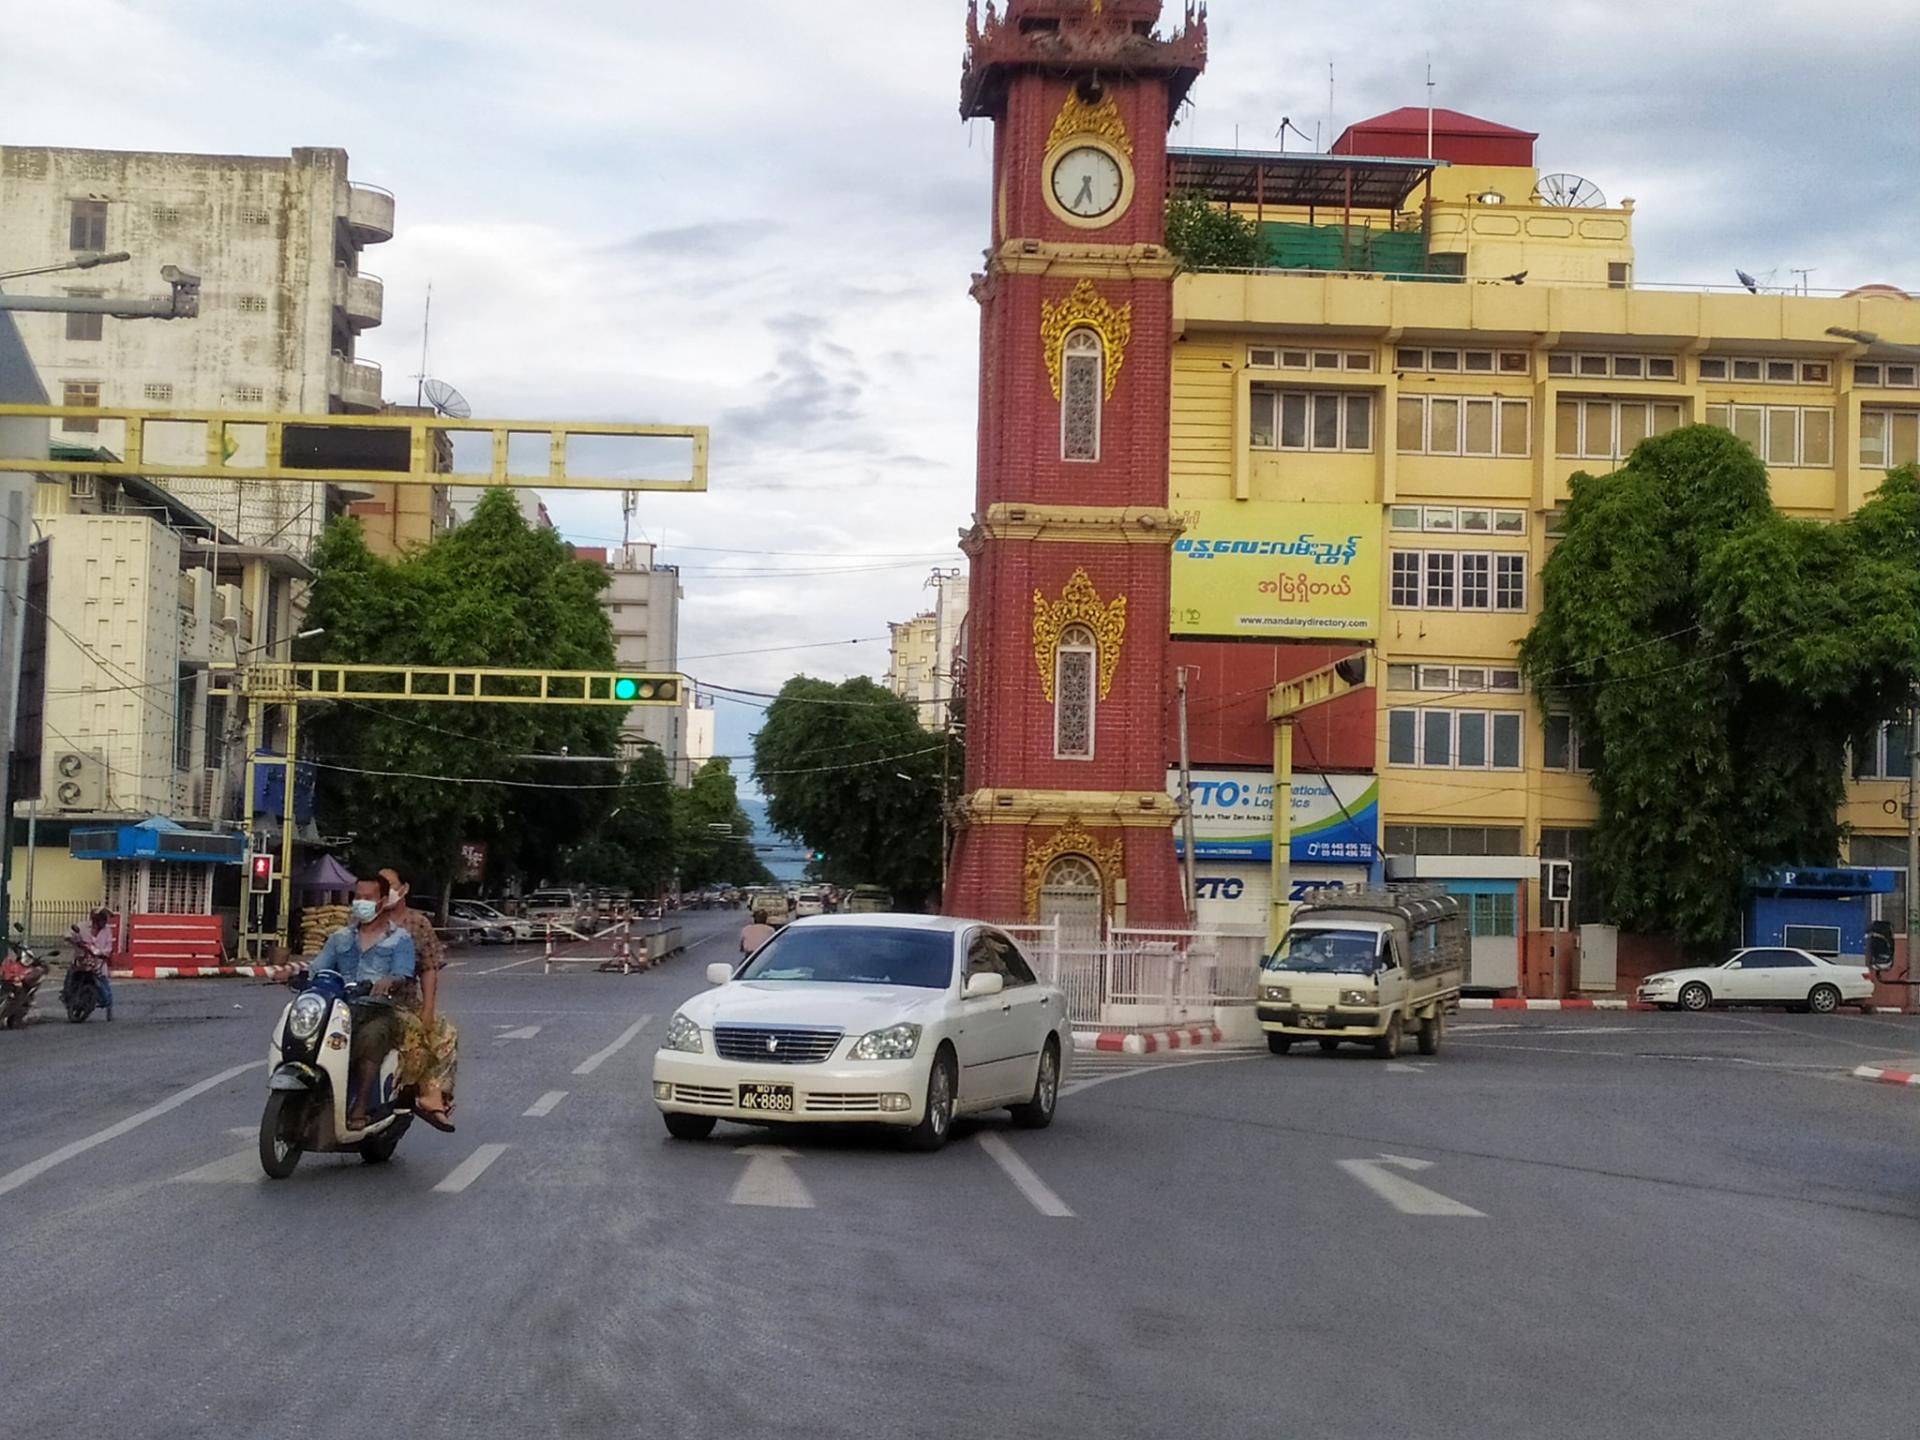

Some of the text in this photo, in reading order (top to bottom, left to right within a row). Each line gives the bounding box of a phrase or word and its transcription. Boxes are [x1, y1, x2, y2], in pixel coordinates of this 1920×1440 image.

[1240, 616, 1368, 628] www.mandalaydirectory.com
[1256, 783, 1332, 796] Intational
[1254, 796, 1311, 809] Logics
[1195, 877, 1244, 899] ZTO
[742, 1093, 791, 1109] 4K-8889
